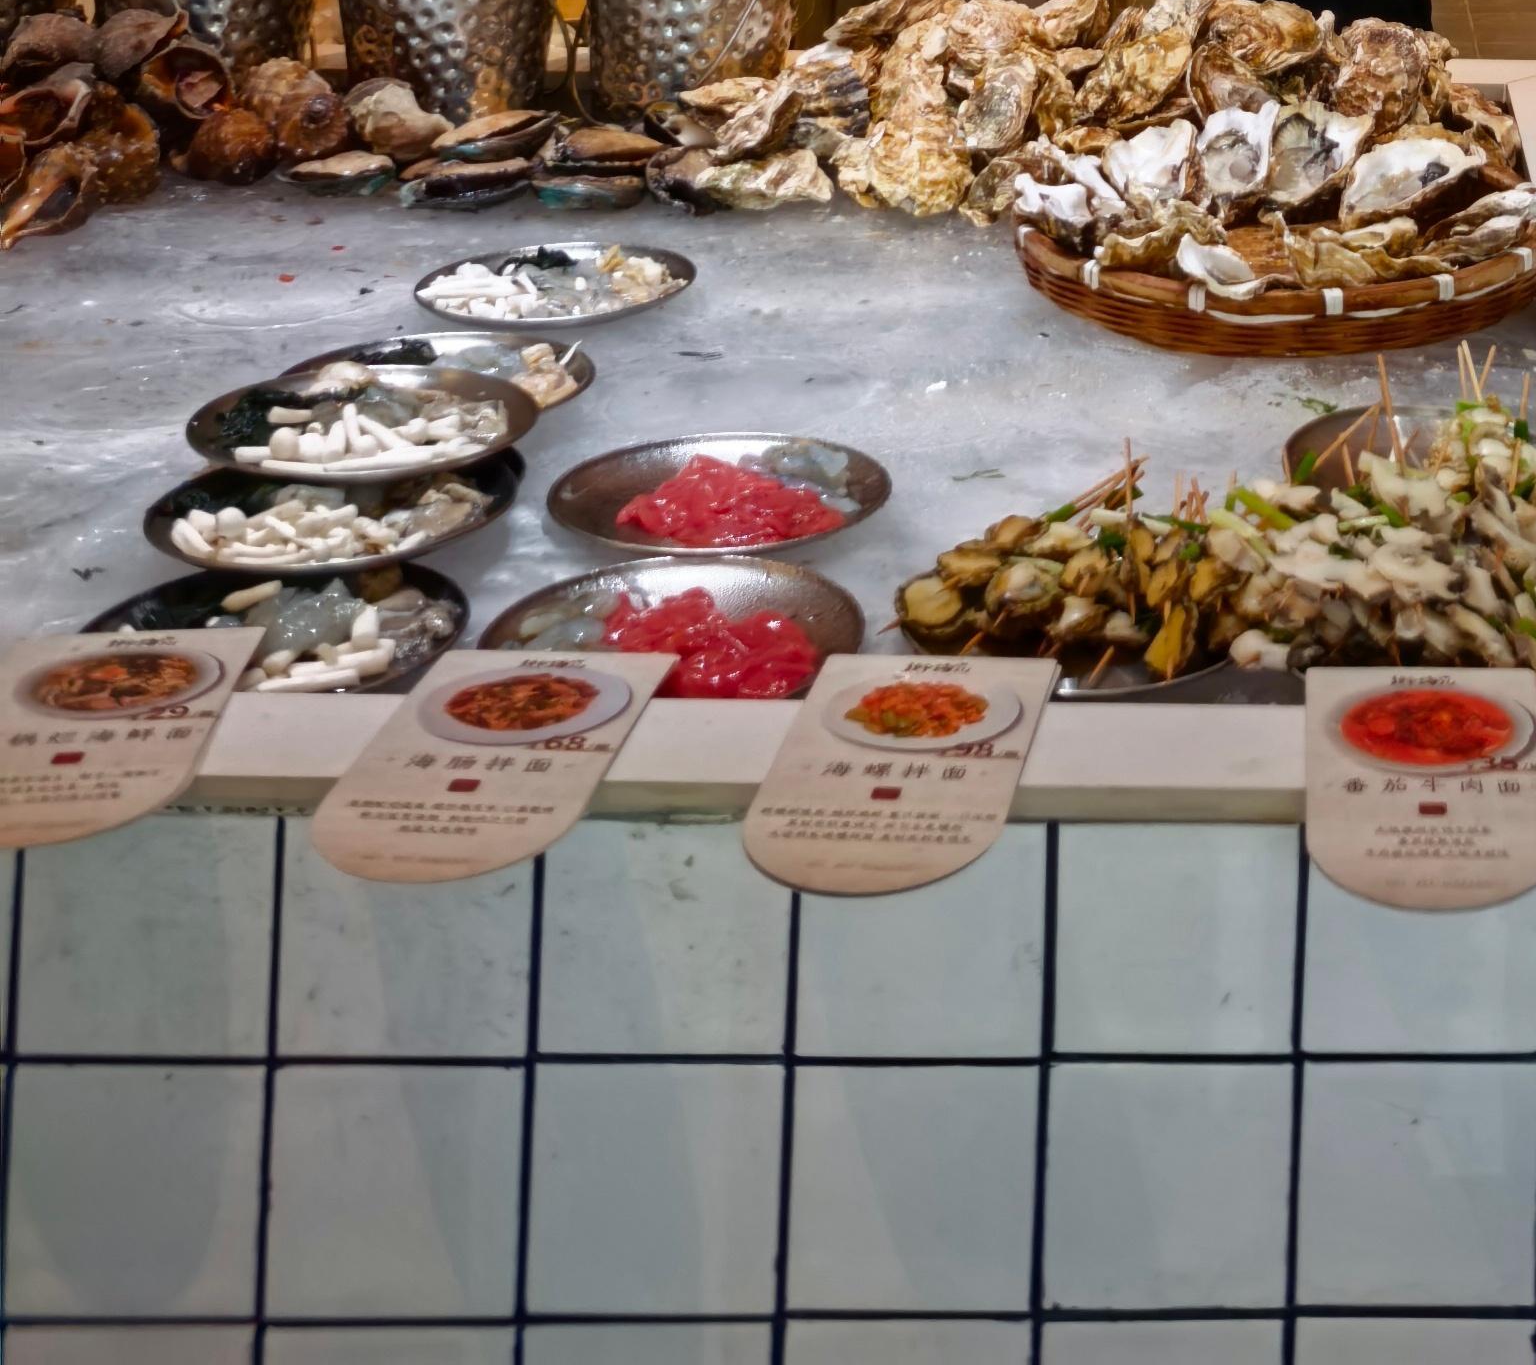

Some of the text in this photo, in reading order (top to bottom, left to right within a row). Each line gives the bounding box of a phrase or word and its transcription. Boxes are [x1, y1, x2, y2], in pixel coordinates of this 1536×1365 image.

[1343, 776, 1521, 793] 番茄牛肉面
